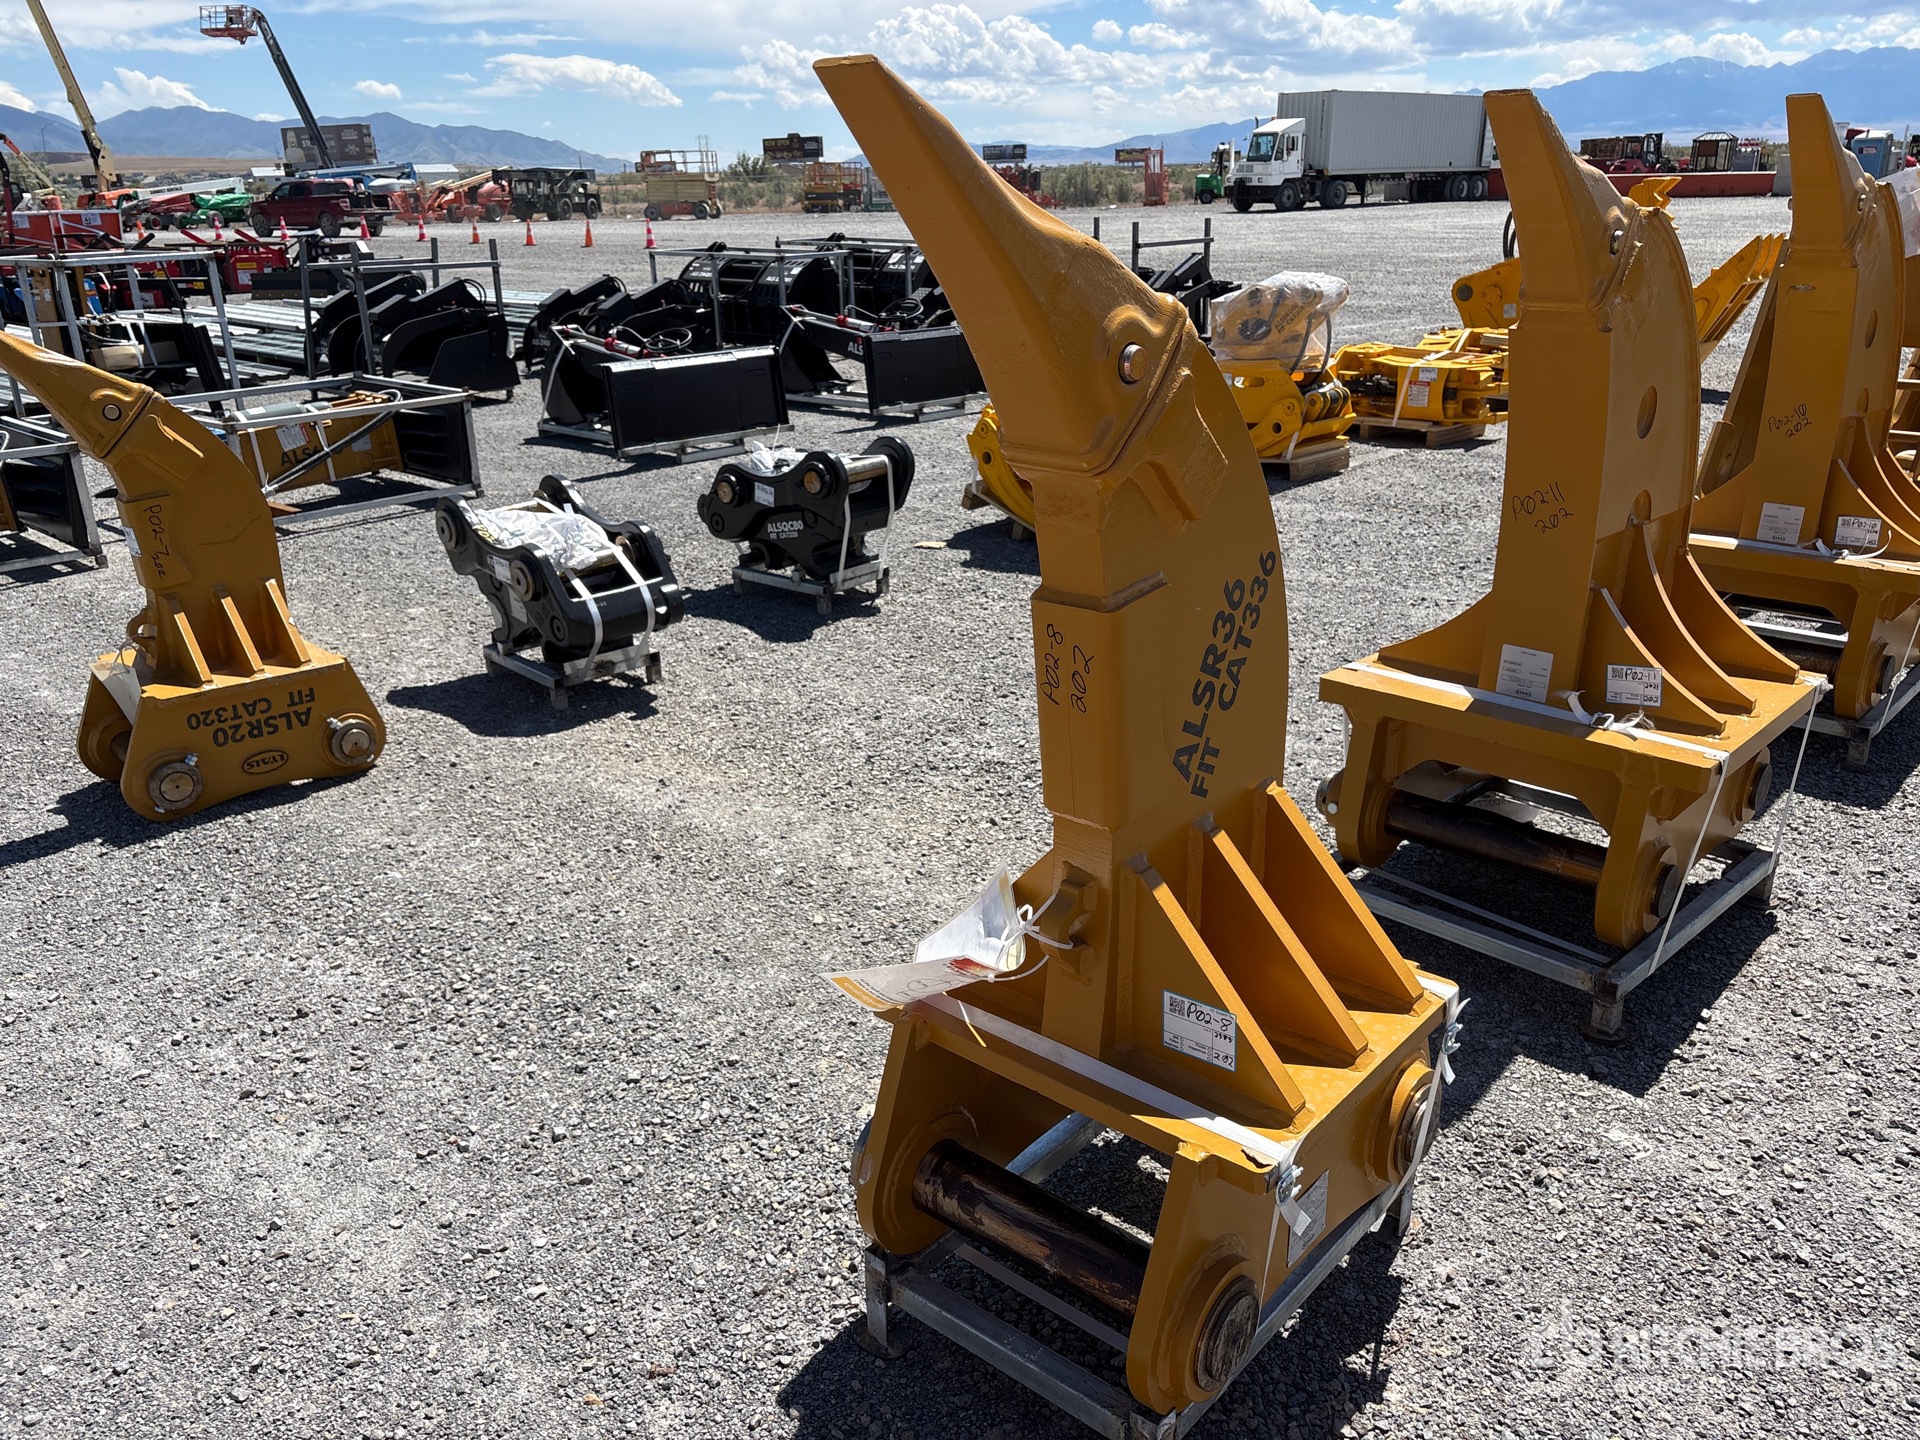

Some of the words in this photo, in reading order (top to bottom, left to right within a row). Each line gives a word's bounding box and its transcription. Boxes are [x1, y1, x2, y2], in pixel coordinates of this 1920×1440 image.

[847, 341, 864, 356] ALS
[1784, 416, 1812, 438] 202
[767, 520, 804, 533] ALSQC80
[1534, 507, 1574, 534] 202
[1070, 645, 1096, 714] 202
[1172, 578, 1246, 784] ALSR36
[1190, 737, 1221, 799] FIT
[1218, 550, 1277, 712] CAT336
[286, 686, 317, 709] FIT
[187, 700, 274, 731] CAT320
[212, 706, 314, 749] ALSR20
[1186, 1002, 1233, 1032] P02-8
[1214, 1052, 1234, 1068] 202
